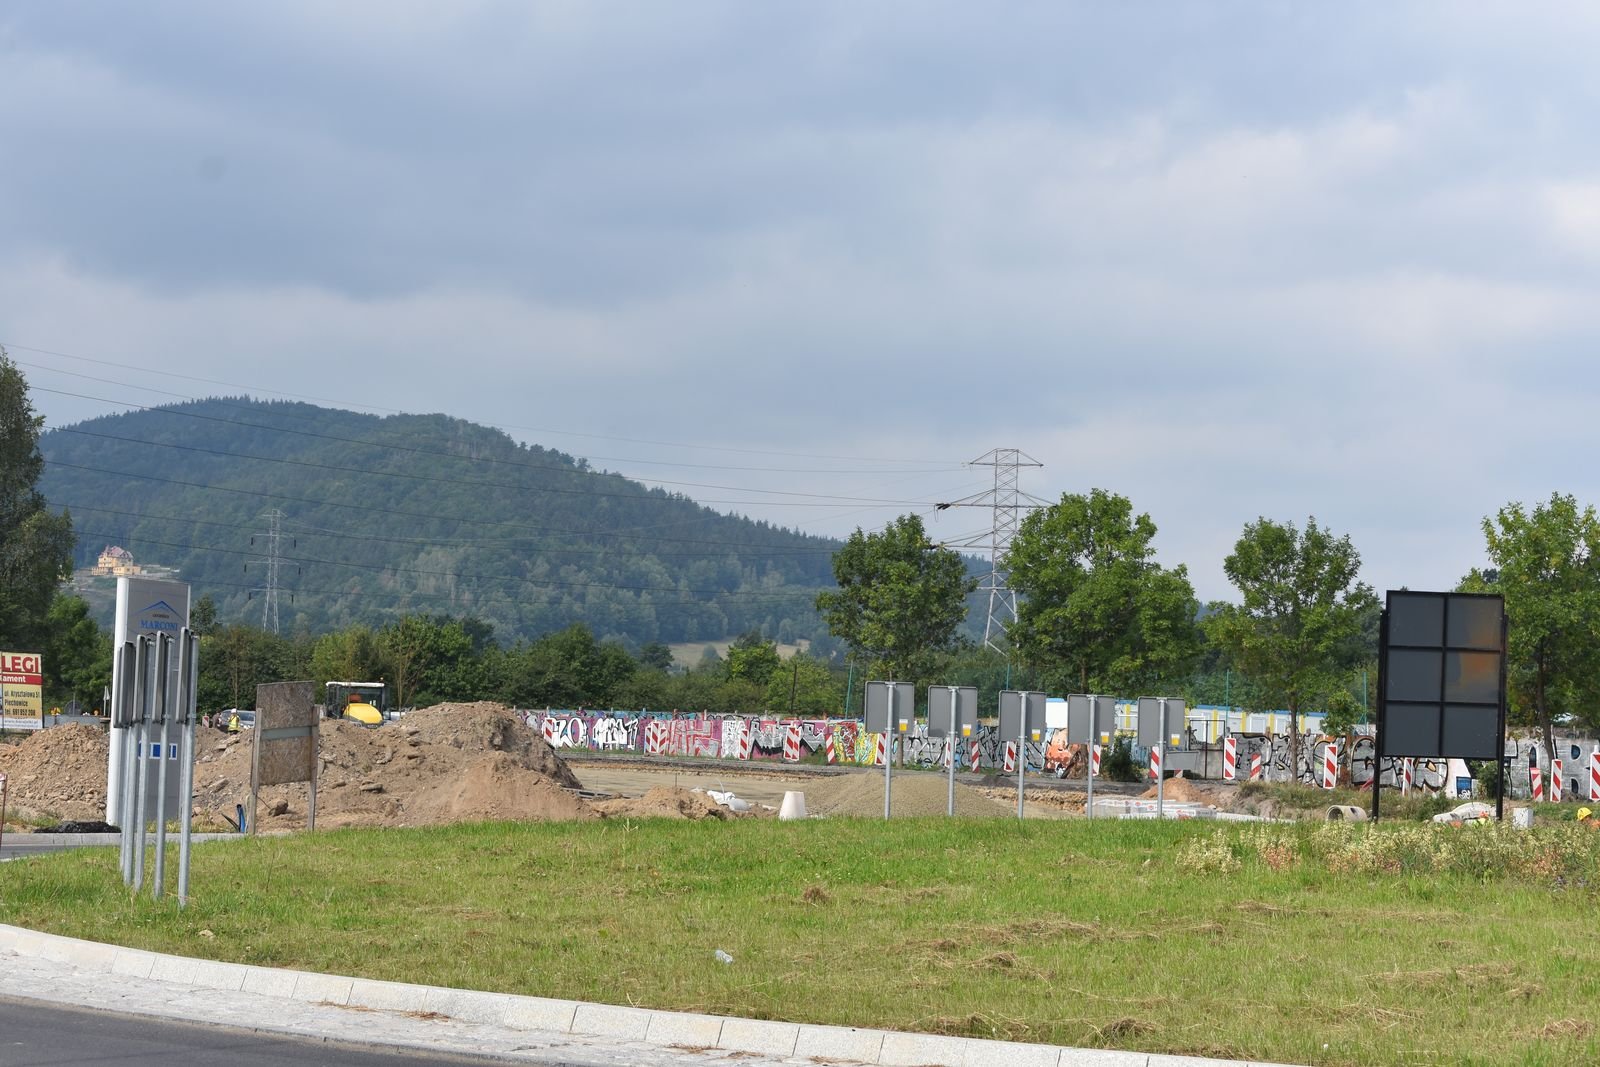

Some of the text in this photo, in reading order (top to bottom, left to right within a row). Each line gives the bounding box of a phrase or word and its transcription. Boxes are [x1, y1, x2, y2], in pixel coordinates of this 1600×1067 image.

[140, 620, 178, 631] MARCONI
[0, 655, 38, 673] LEGI
[0, 675, 26, 683] ament
